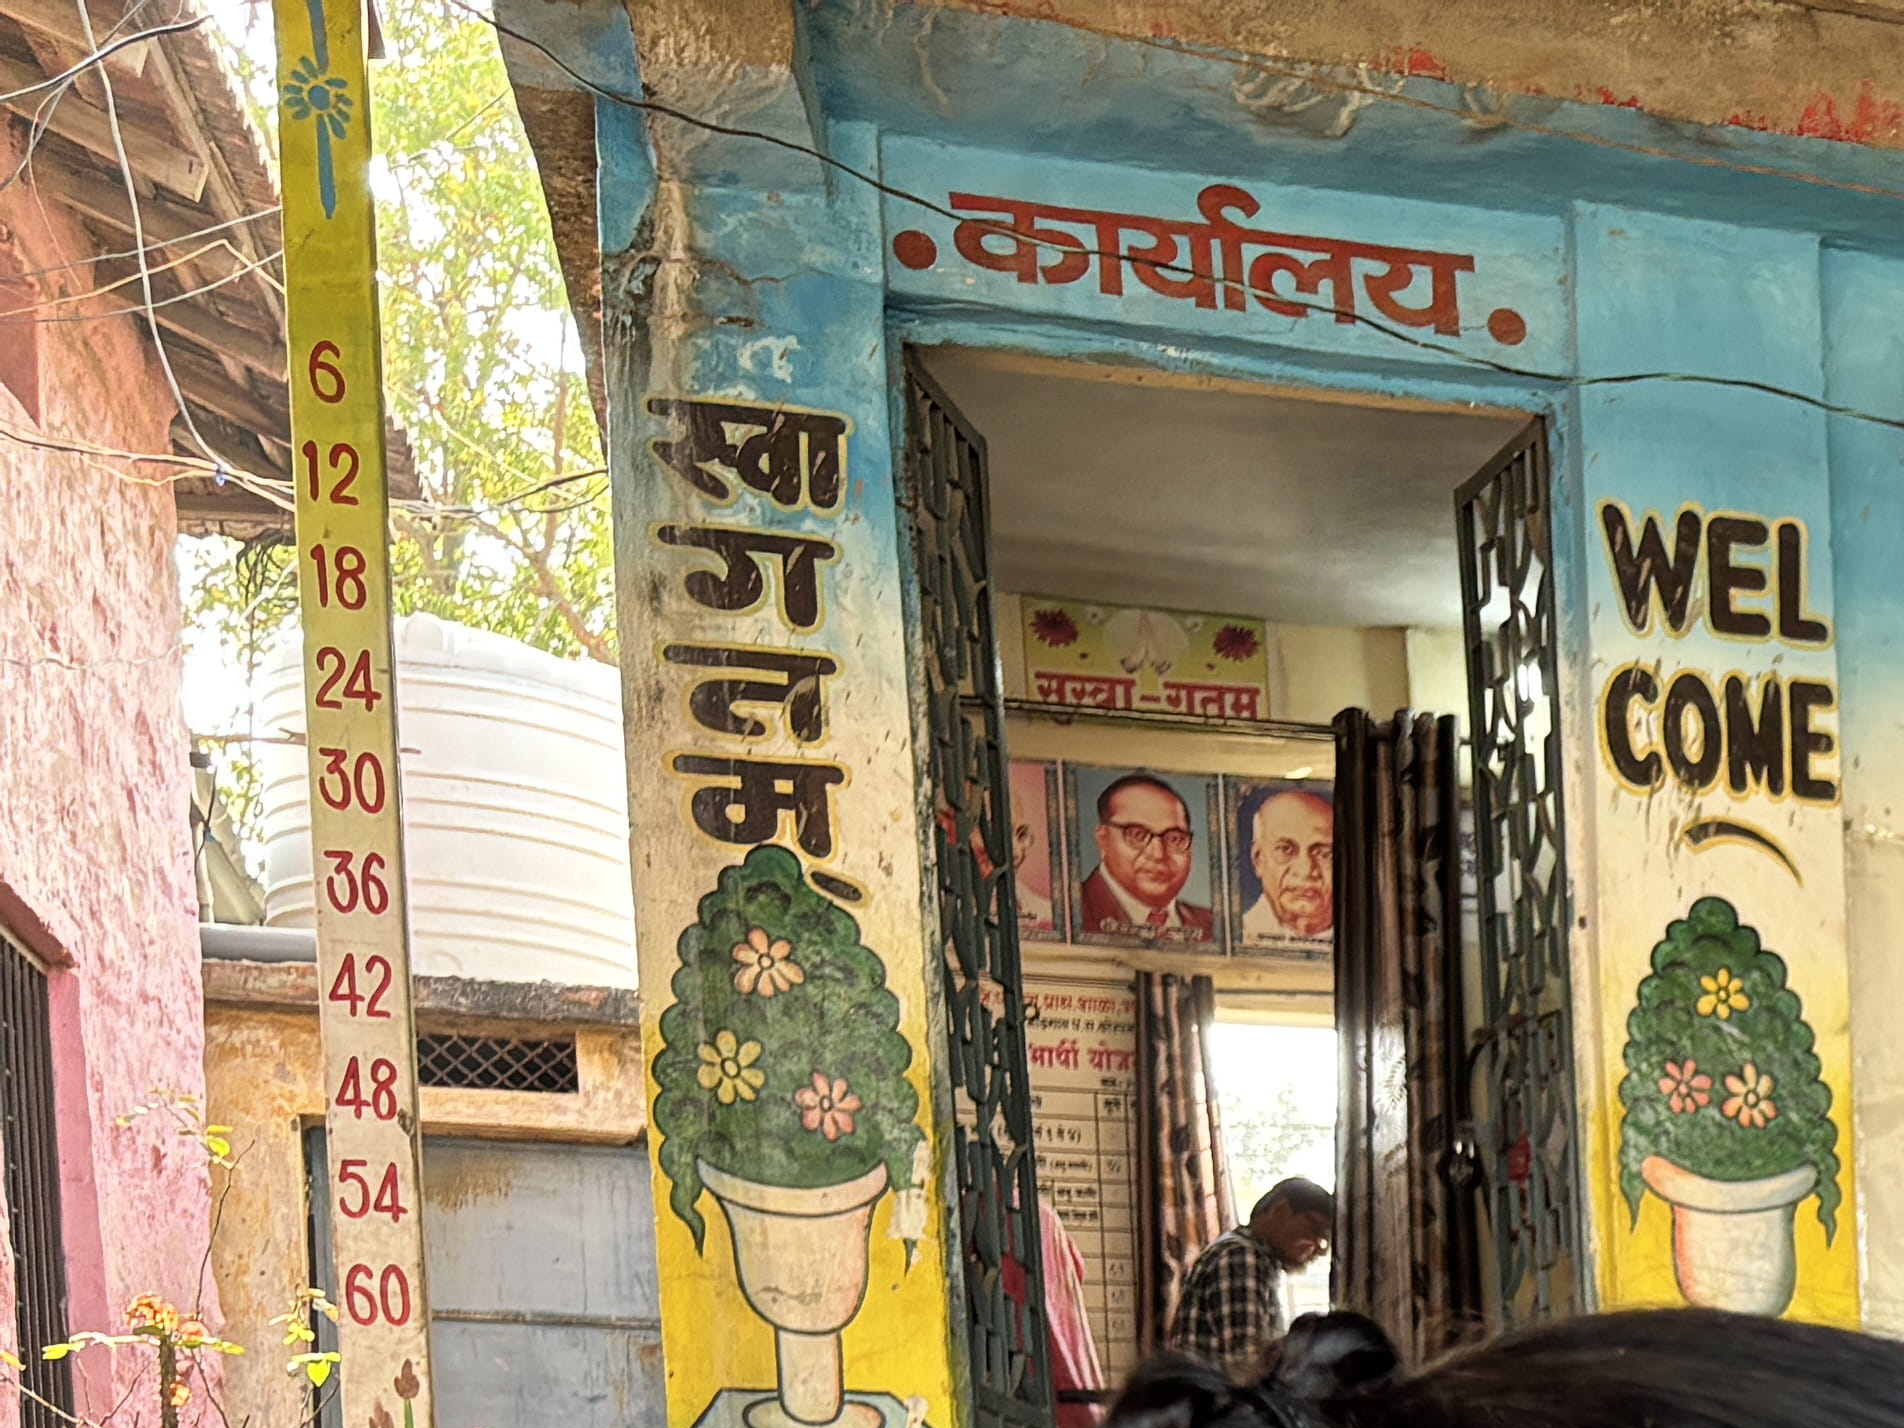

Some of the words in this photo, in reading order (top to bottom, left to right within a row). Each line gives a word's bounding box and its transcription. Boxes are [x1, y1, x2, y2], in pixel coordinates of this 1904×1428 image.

[949, 184, 1475, 338] कार्यालय
[309, 342, 346, 404] 6
[302, 443, 361, 506] 12
[311, 546, 368, 609] 18
[1601, 502, 1829, 644] WEL
[315, 648, 381, 713] 24
[1604, 668, 1841, 801] COME
[321, 748, 385, 814] 30
[325, 851, 389, 914] 36
[326, 955, 393, 1018] 42
[333, 1057, 400, 1121] 48
[337, 1160, 407, 1222] 54
[344, 1263, 412, 1328] 60
